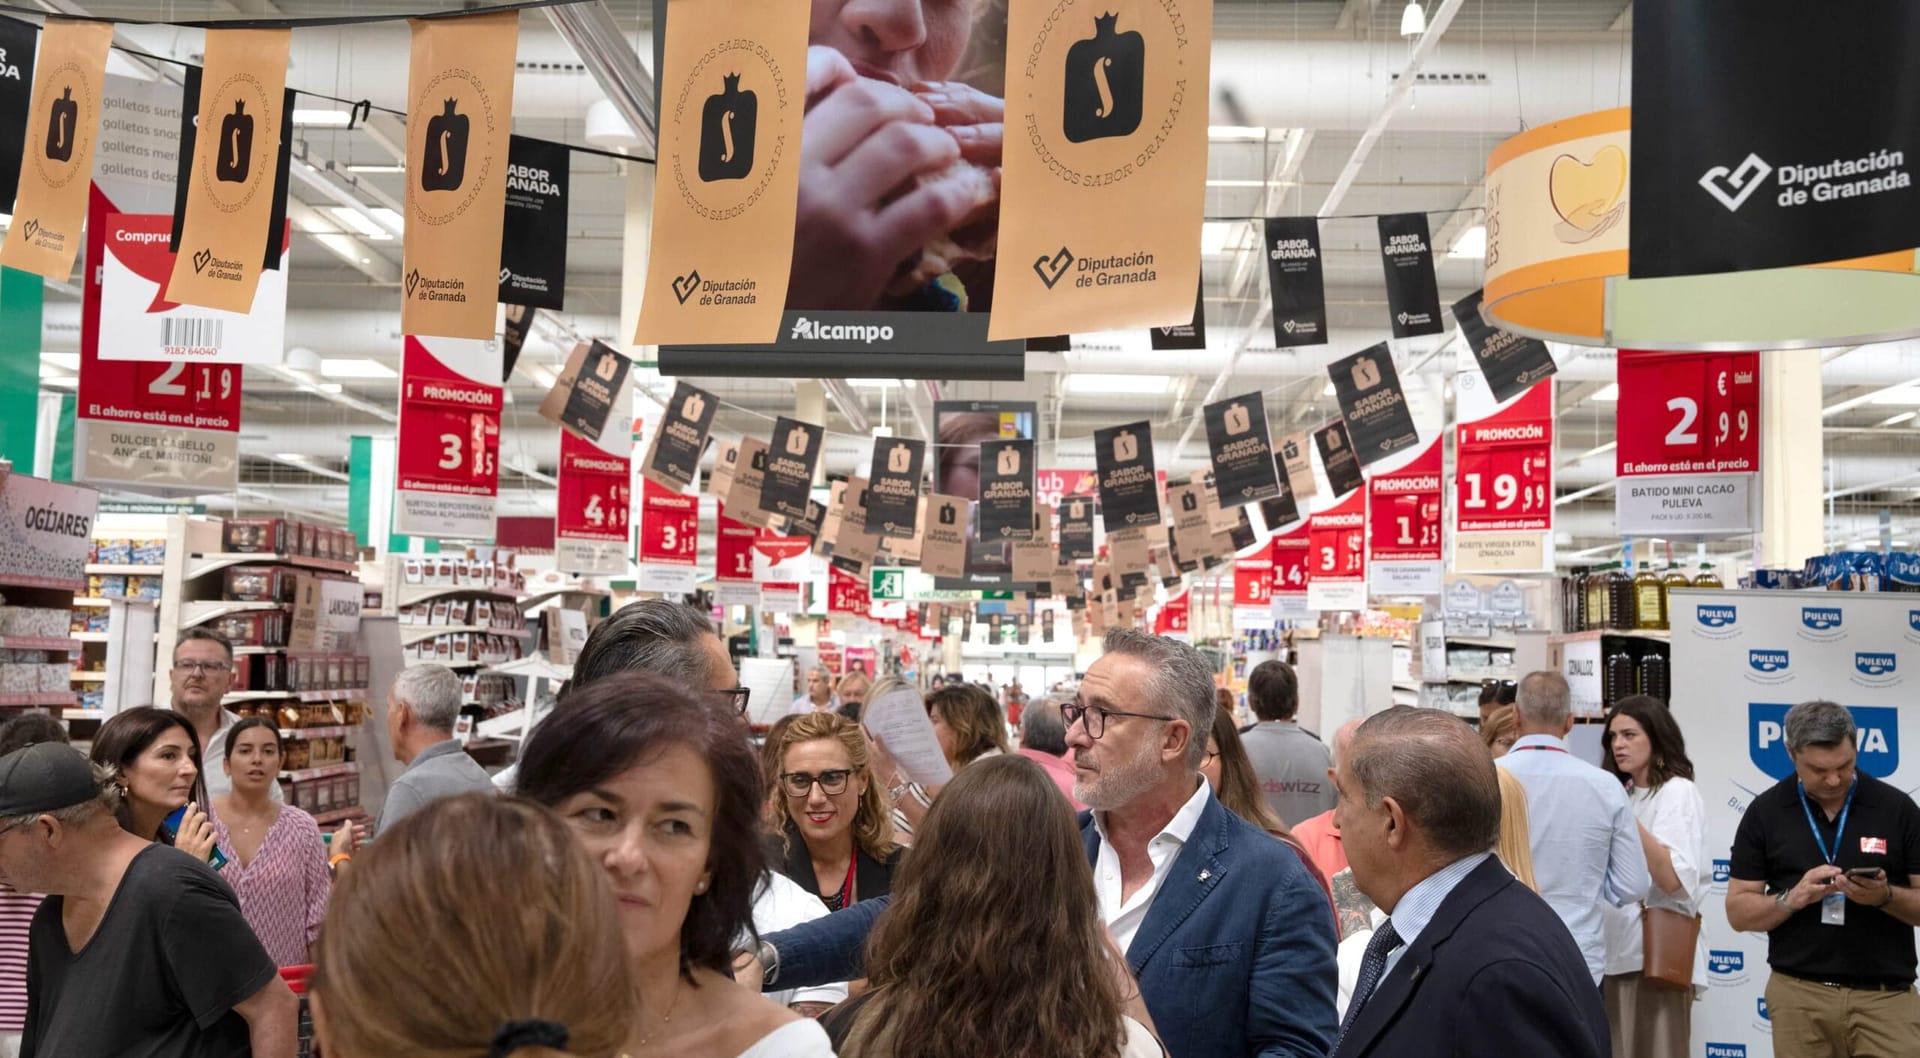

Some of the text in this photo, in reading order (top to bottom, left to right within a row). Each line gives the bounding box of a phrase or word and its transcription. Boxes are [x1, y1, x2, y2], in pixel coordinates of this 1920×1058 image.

[1025, 0, 1074, 79] PRODUCT
[674, 38, 788, 125] PRODUCTOS SABOR GRANADA
[103, 97, 182, 119] galletas surti
[102, 119, 180, 140] galletas snac
[1025, 79, 1187, 187] PRODUCTOS SABOR GRANADA
[101, 141, 178, 161] galletas meri
[101, 162, 178, 183] galletas desc
[507, 164, 549, 182] ABOR
[1778, 149, 1904, 187] Diputación
[672, 134, 785, 221] PRODUCTOS SABOR GRANADA
[507, 177, 560, 197] ANADA
[1777, 170, 1911, 207] de Granada
[116, 230, 172, 245] Comprue
[1277, 238, 1309, 250] SABOR
[1389, 234, 1419, 246] SABOR
[1271, 248, 1316, 260] GRANADA
[1384, 243, 1427, 256] GRANADA
[210, 257, 243, 272] Diputación
[1077, 252, 1154, 273] Diputación
[208, 268, 242, 283] de Granada
[1075, 268, 1157, 288] de Granada
[420, 277, 464, 292] Diputación
[702, 279, 756, 295] Diputación
[419, 291, 466, 303] de Granada
[699, 293, 756, 306] de Granada
[791, 317, 894, 344] Alcampo
[1717, 371, 1727, 396] €
[424, 385, 493, 405] PROMOCIÓN
[1354, 388, 1392, 410] SABOR
[1349, 393, 1402, 421] GRANADA
[89, 404, 229, 428] El ahorro está en el precio
[110, 433, 157, 448] DULCES
[1476, 424, 1543, 441] PROMOCIÓN
[1216, 443, 1268, 463] GRANADA
[1222, 437, 1258, 453] SABOR
[769, 463, 809, 480] GRANADA
[777, 457, 806, 470] SABOR
[1110, 465, 1145, 478] SABOR
[1624, 457, 1749, 473] El ahorro está en el precio
[880, 477, 912, 487] SABOR
[990, 482, 1023, 491] SABOR
[1037, 471, 1064, 491] ub
[1104, 473, 1153, 488] GRANADA
[1374, 477, 1439, 491] PROMOCIÓN
[873, 484, 917, 497] GRANADA
[984, 489, 1030, 499] GRANADA
[1632, 484, 1735, 498] BATIDO MINI CACAO
[1662, 498, 1703, 509] PULEVA
[25, 502, 89, 538] OGÍJARES
[1699, 609, 1734, 619] PULEVA
[1804, 611, 1840, 622] PULEVA
[1751, 653, 1786, 664] PULEVA
[1857, 656, 1893, 667] PULEVA
[1263, 779, 1321, 794] dswizz
[1708, 1046, 1744, 1057] PULEVA
